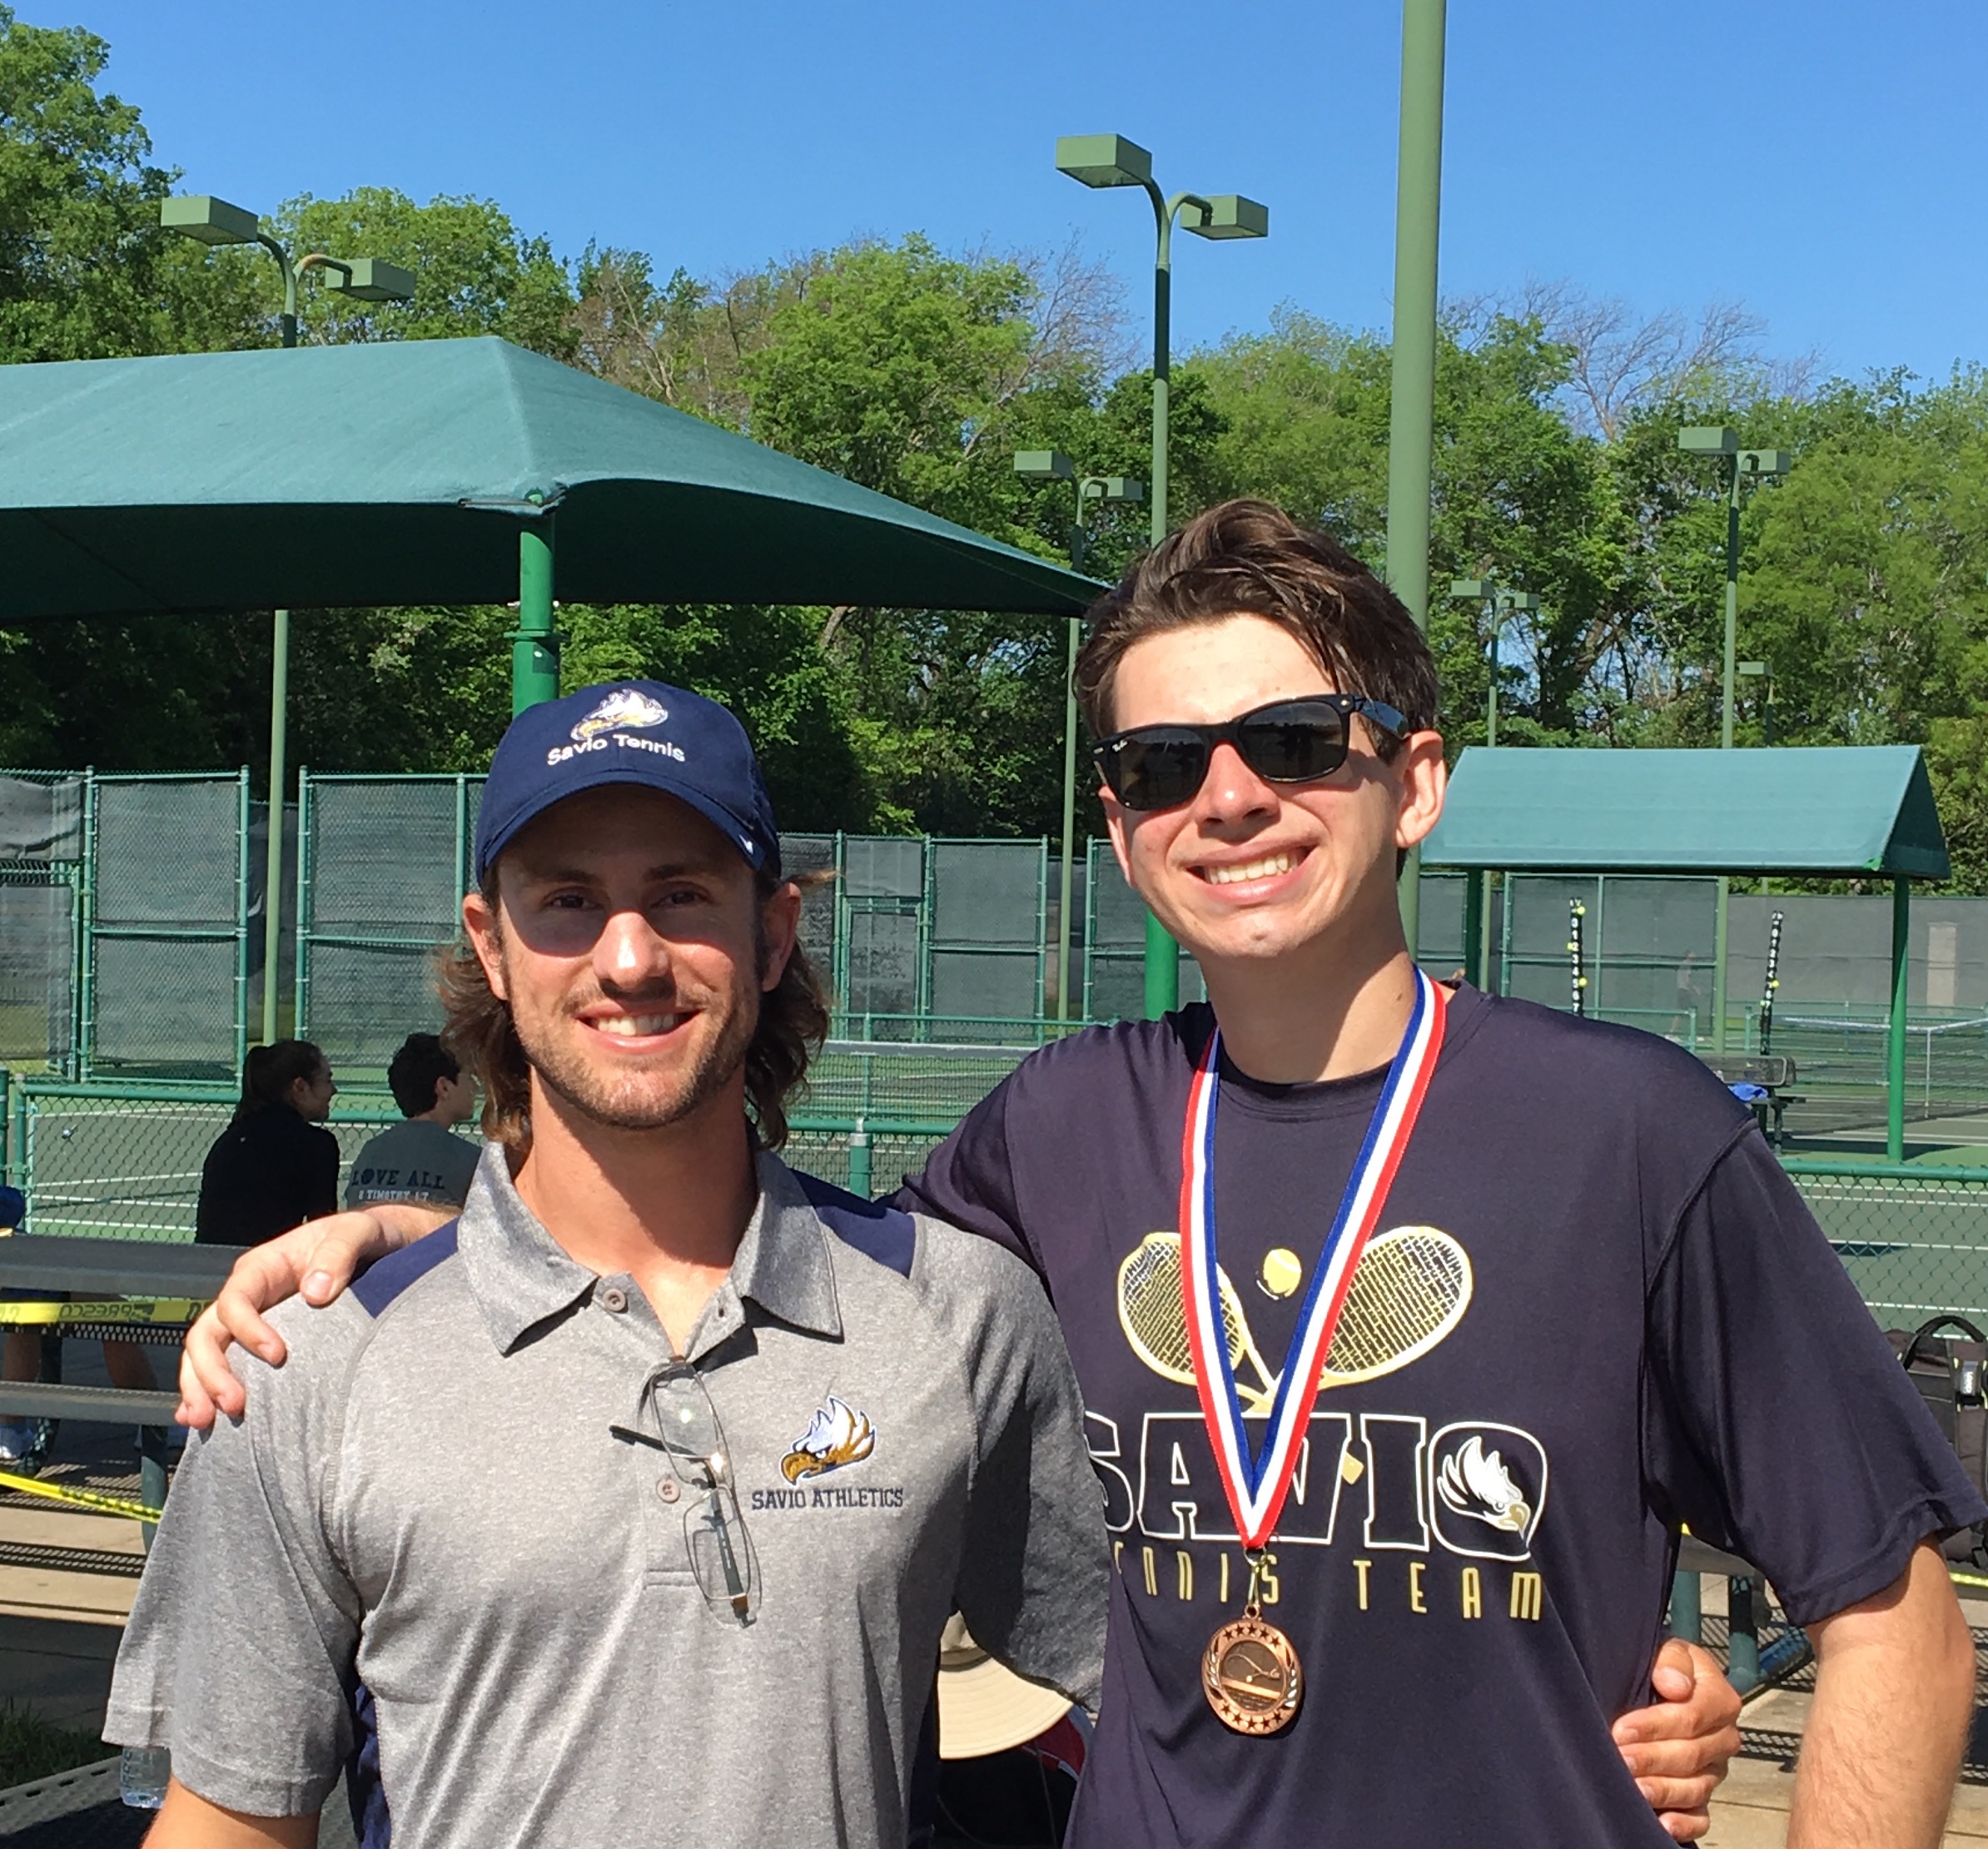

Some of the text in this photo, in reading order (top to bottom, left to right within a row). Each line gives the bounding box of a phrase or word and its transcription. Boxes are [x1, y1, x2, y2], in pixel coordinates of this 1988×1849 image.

[547, 733, 685, 766] Savio Tennis
[351, 1168, 445, 1190] LOVE ALL
[366, 1189, 410, 1200] TIMOTHY
[751, 1487, 904, 1510] SAVIO ATHLETICS
[1352, 1559, 1543, 1622] TEAM
